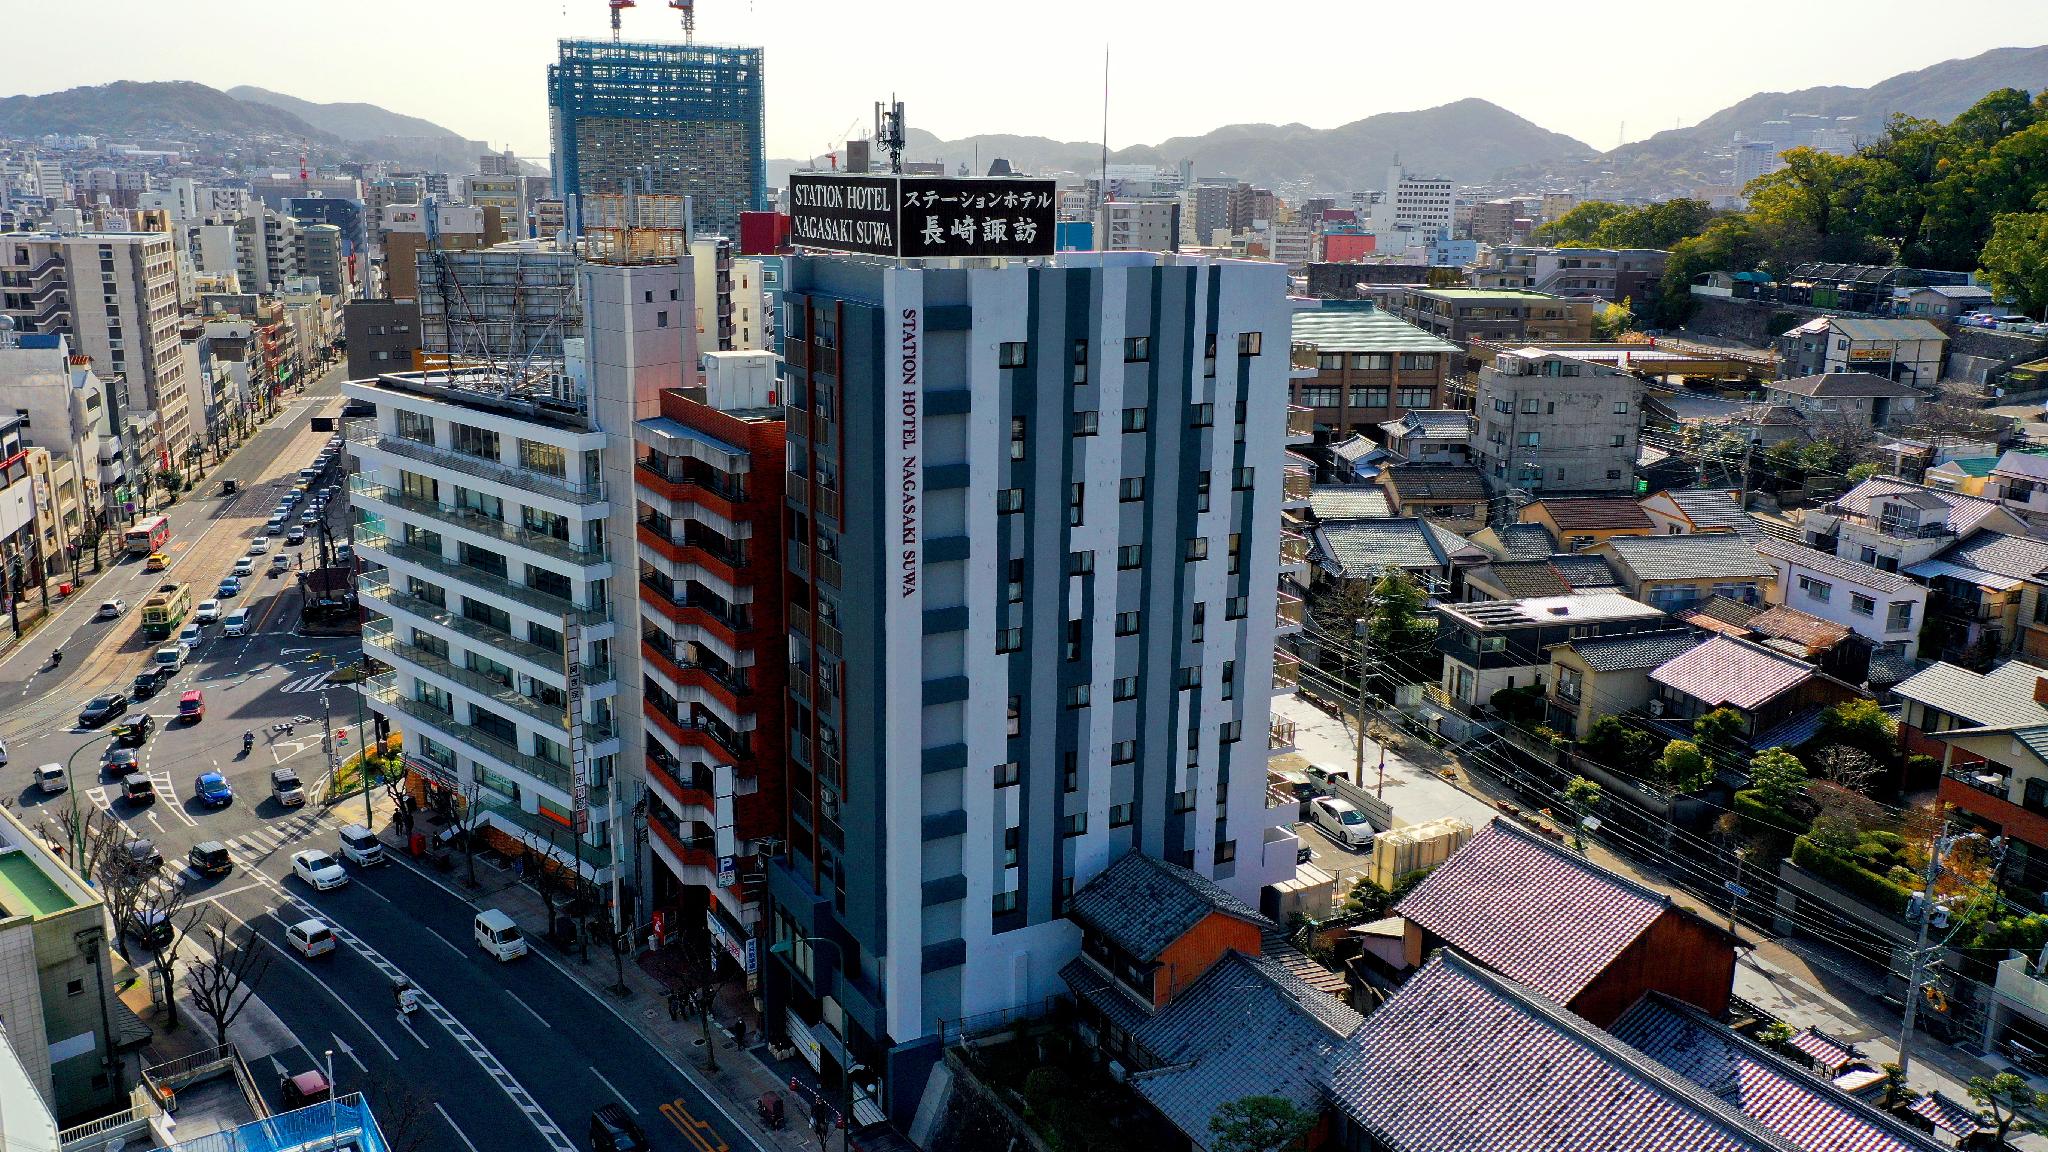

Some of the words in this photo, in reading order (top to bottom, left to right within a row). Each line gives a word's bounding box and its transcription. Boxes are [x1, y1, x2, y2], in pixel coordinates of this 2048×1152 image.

[795, 183, 843, 209] STATION
[846, 185, 891, 212] HOTEL
[903, 190, 1053, 210] ステーションホテル
[794, 215, 854, 244] NAGASAKI
[856, 219, 893, 248] SUWA
[920, 215, 1038, 246] 長崎諏訪
[902, 308, 916, 385] STATION
[902, 390, 916, 450] HOTEL
[902, 456, 916, 545] NAGASAKI
[902, 550, 916, 597] SUWA
[720, 857, 733, 872] P
